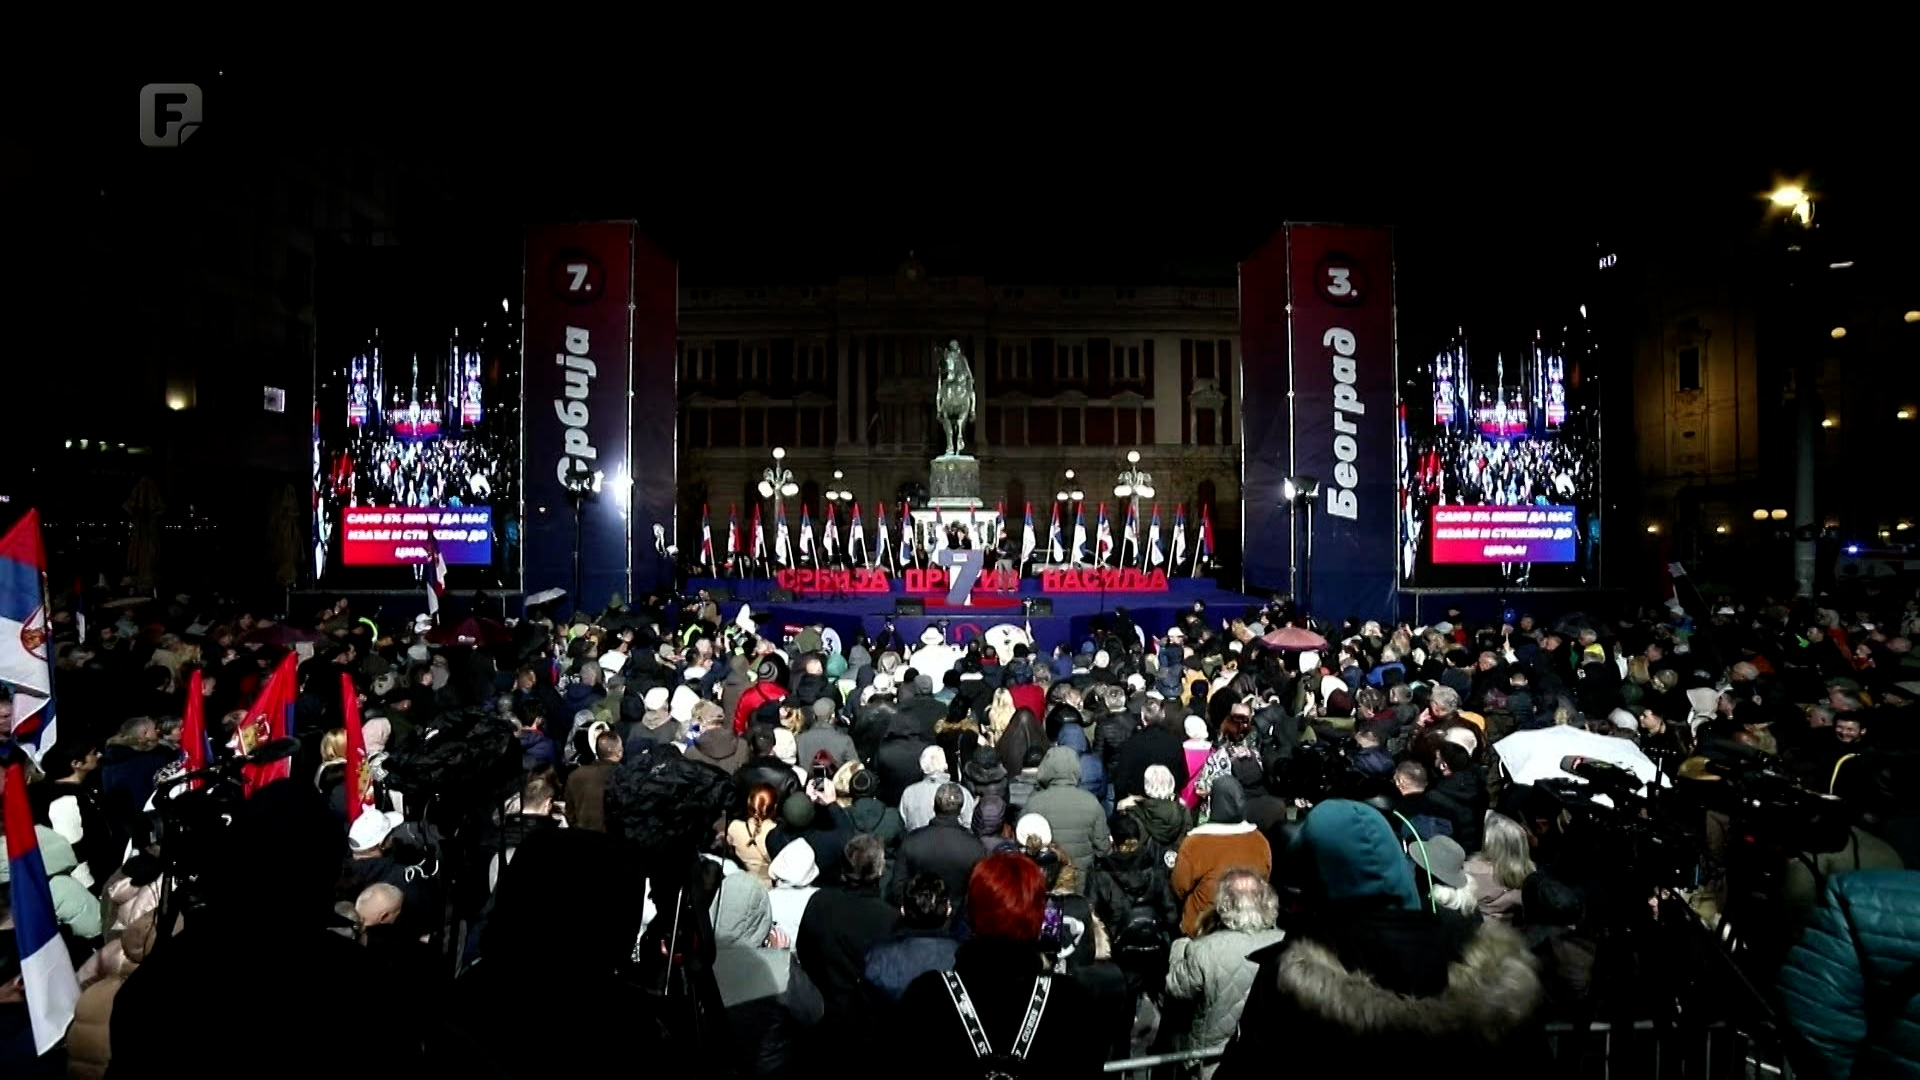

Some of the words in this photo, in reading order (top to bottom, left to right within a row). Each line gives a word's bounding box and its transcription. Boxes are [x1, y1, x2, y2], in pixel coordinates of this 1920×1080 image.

[567, 264, 592, 291] 7.
[1327, 267, 1358, 296] 3.
[1322, 326, 1365, 520] Београд
[346, 513, 383, 524] САМО
[440, 513, 460, 525] ДА
[461, 512, 489, 524] НАС
[1528, 511, 1546, 524] ДА
[1547, 511, 1573, 522] НАС
[777, 567, 890, 592] СРБИЈА
[1043, 567, 1169, 592] НАСИЉА
